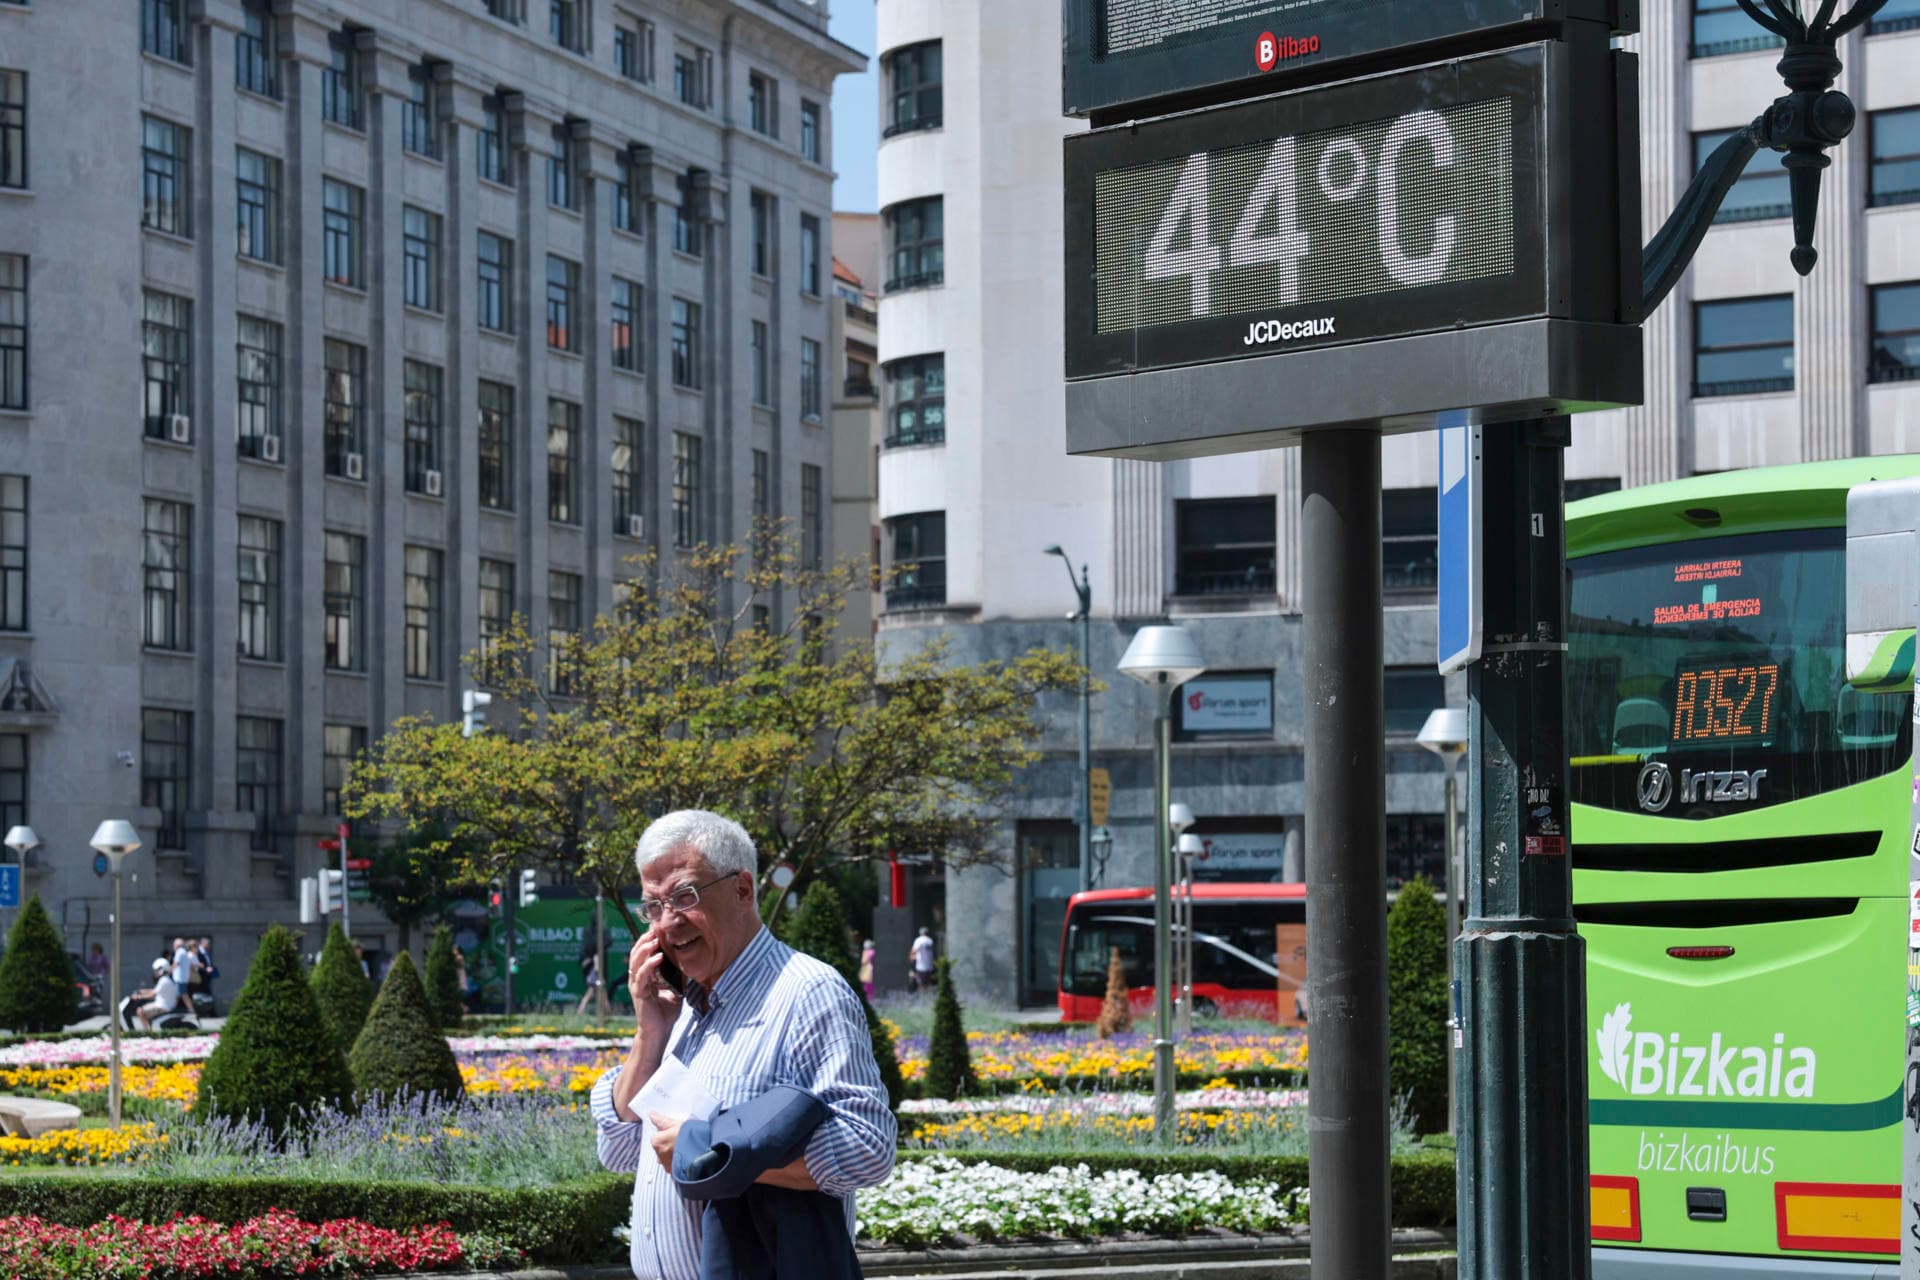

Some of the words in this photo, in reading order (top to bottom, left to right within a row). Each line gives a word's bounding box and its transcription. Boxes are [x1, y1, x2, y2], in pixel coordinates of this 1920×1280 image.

[1259, 34, 1320, 65] Bilbao
[1243, 317, 1335, 345] JCDecaux
[1674, 562, 1710, 574] LARRIALDI
[1711, 559, 1742, 570] IRTEERA
[1654, 605, 1684, 617] SALIDA
[1688, 603, 1700, 612] DE
[1704, 598, 1760, 612] EMERGENCIA
[1673, 665, 1778, 739] A3527
[1631, 1031, 1816, 1098] Bizkaia
[1637, 1131, 1776, 1175] bizkaibus
